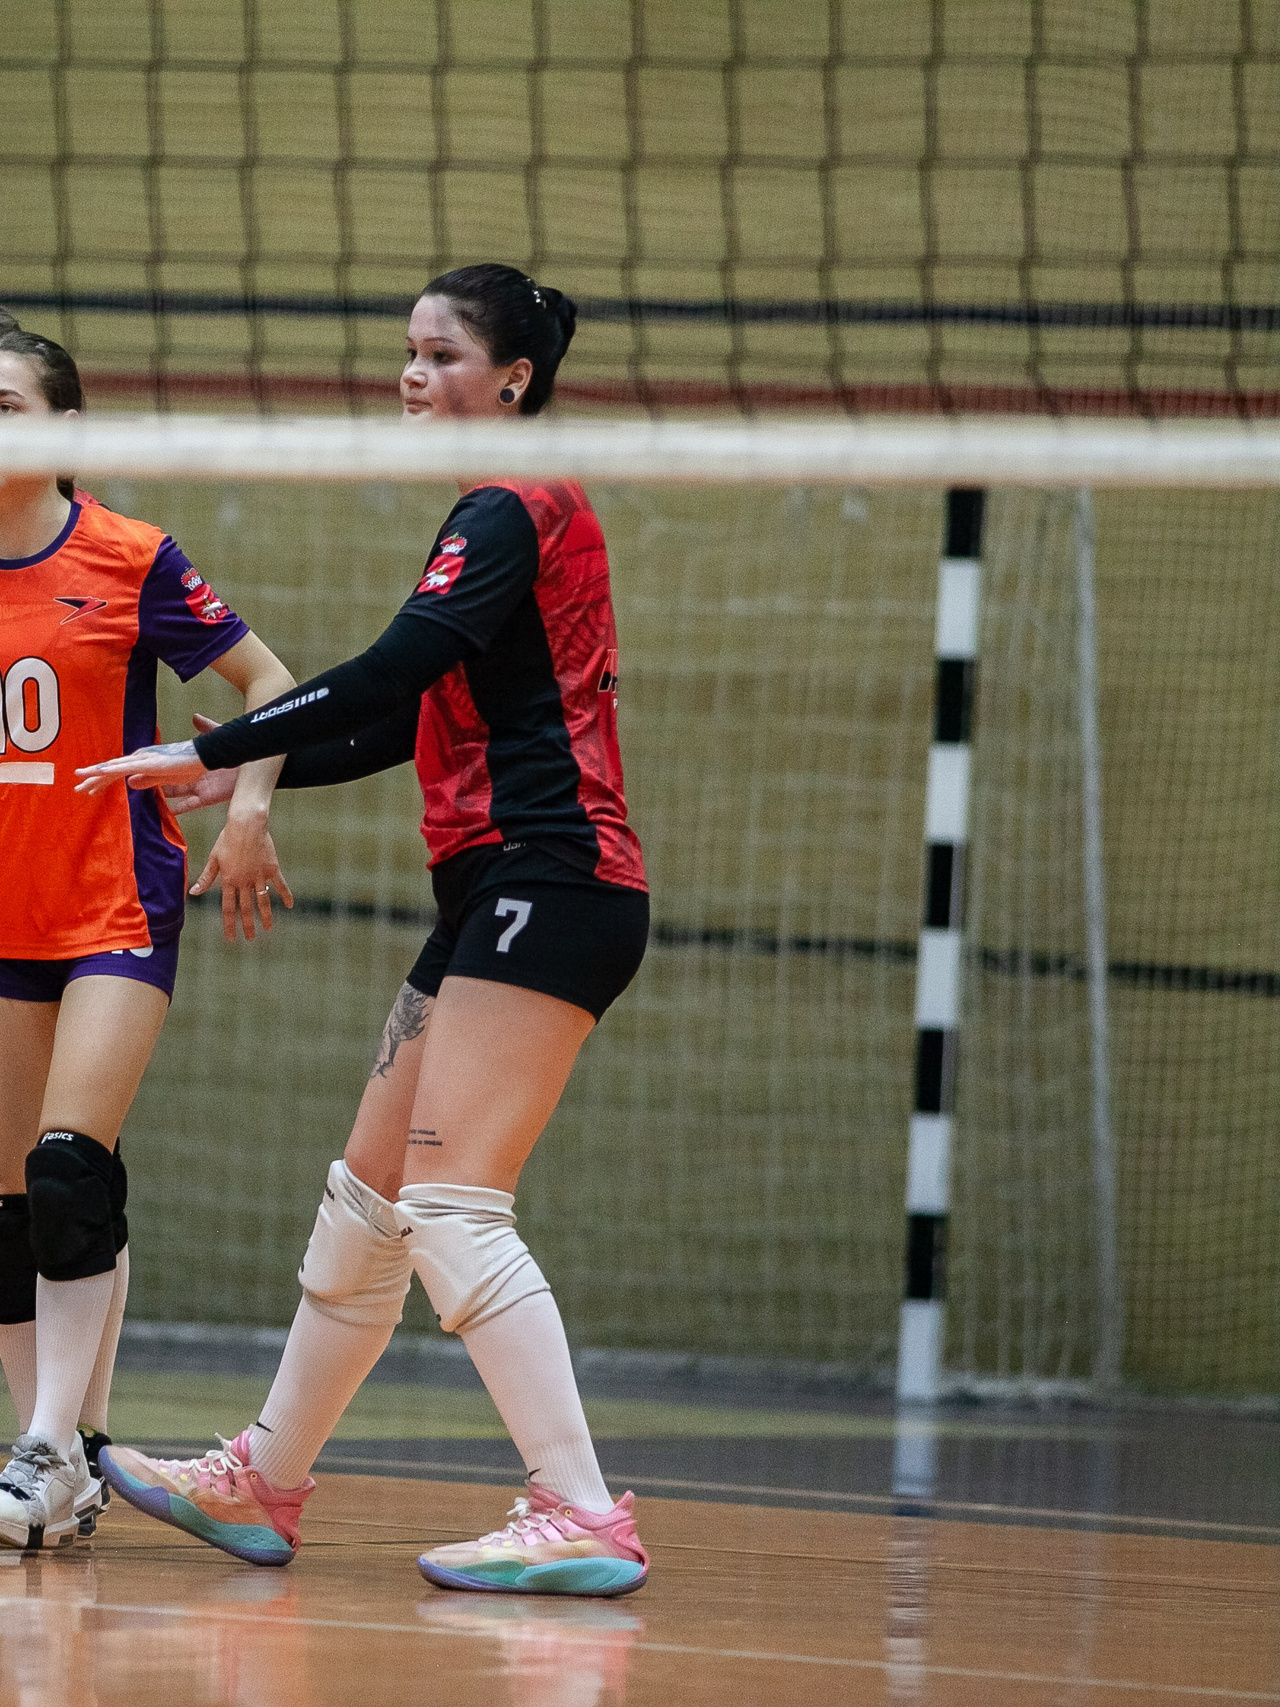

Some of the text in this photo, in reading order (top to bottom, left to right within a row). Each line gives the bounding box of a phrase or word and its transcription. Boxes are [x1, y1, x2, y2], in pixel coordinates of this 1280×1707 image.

[250, 699, 295, 724] SPORT
[494, 897, 533, 953] 7
[47, 1131, 75, 1142] asics
